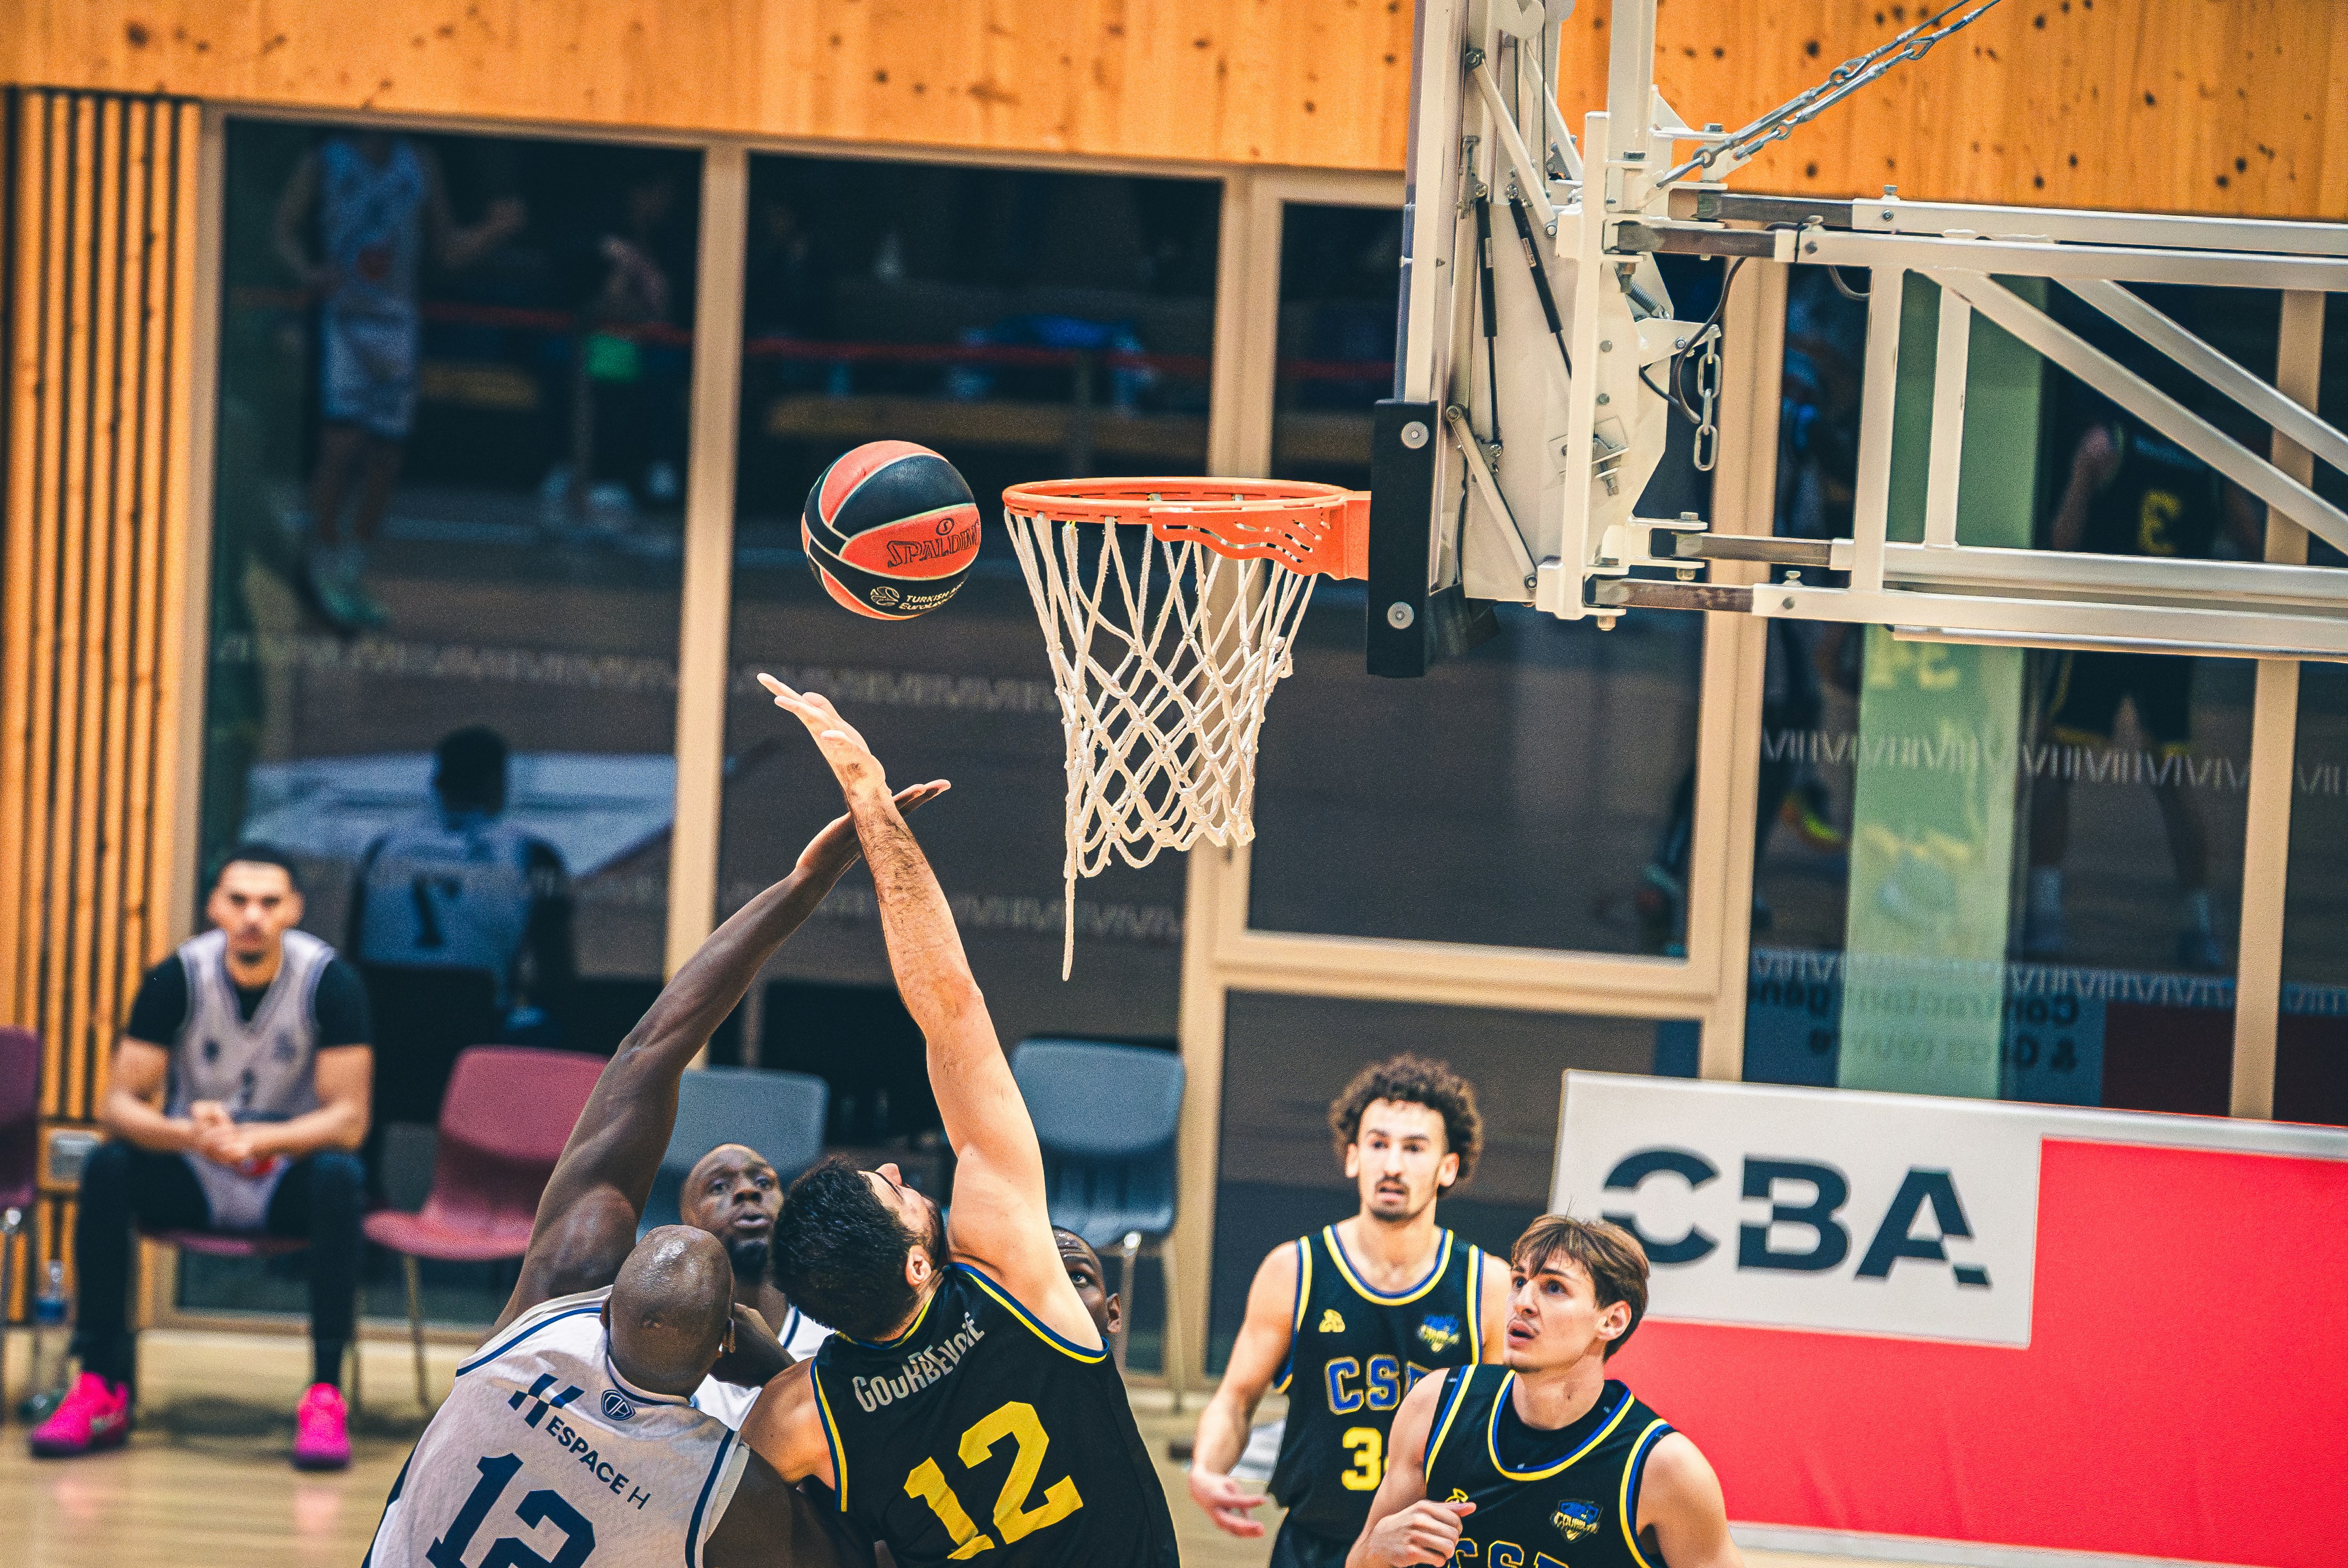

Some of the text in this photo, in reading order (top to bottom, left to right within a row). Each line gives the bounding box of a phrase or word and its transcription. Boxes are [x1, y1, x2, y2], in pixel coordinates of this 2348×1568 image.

[887, 519, 980, 568] SPALDIN
[907, 591, 949, 603] TURKISH
[1602, 1146, 1992, 1289] CBA
[545, 1415, 651, 1510] ESPACE H
[903, 1401, 1084, 1560] 12
[1341, 1427, 1389, 1491] 3
[425, 1452, 596, 1568] 12
